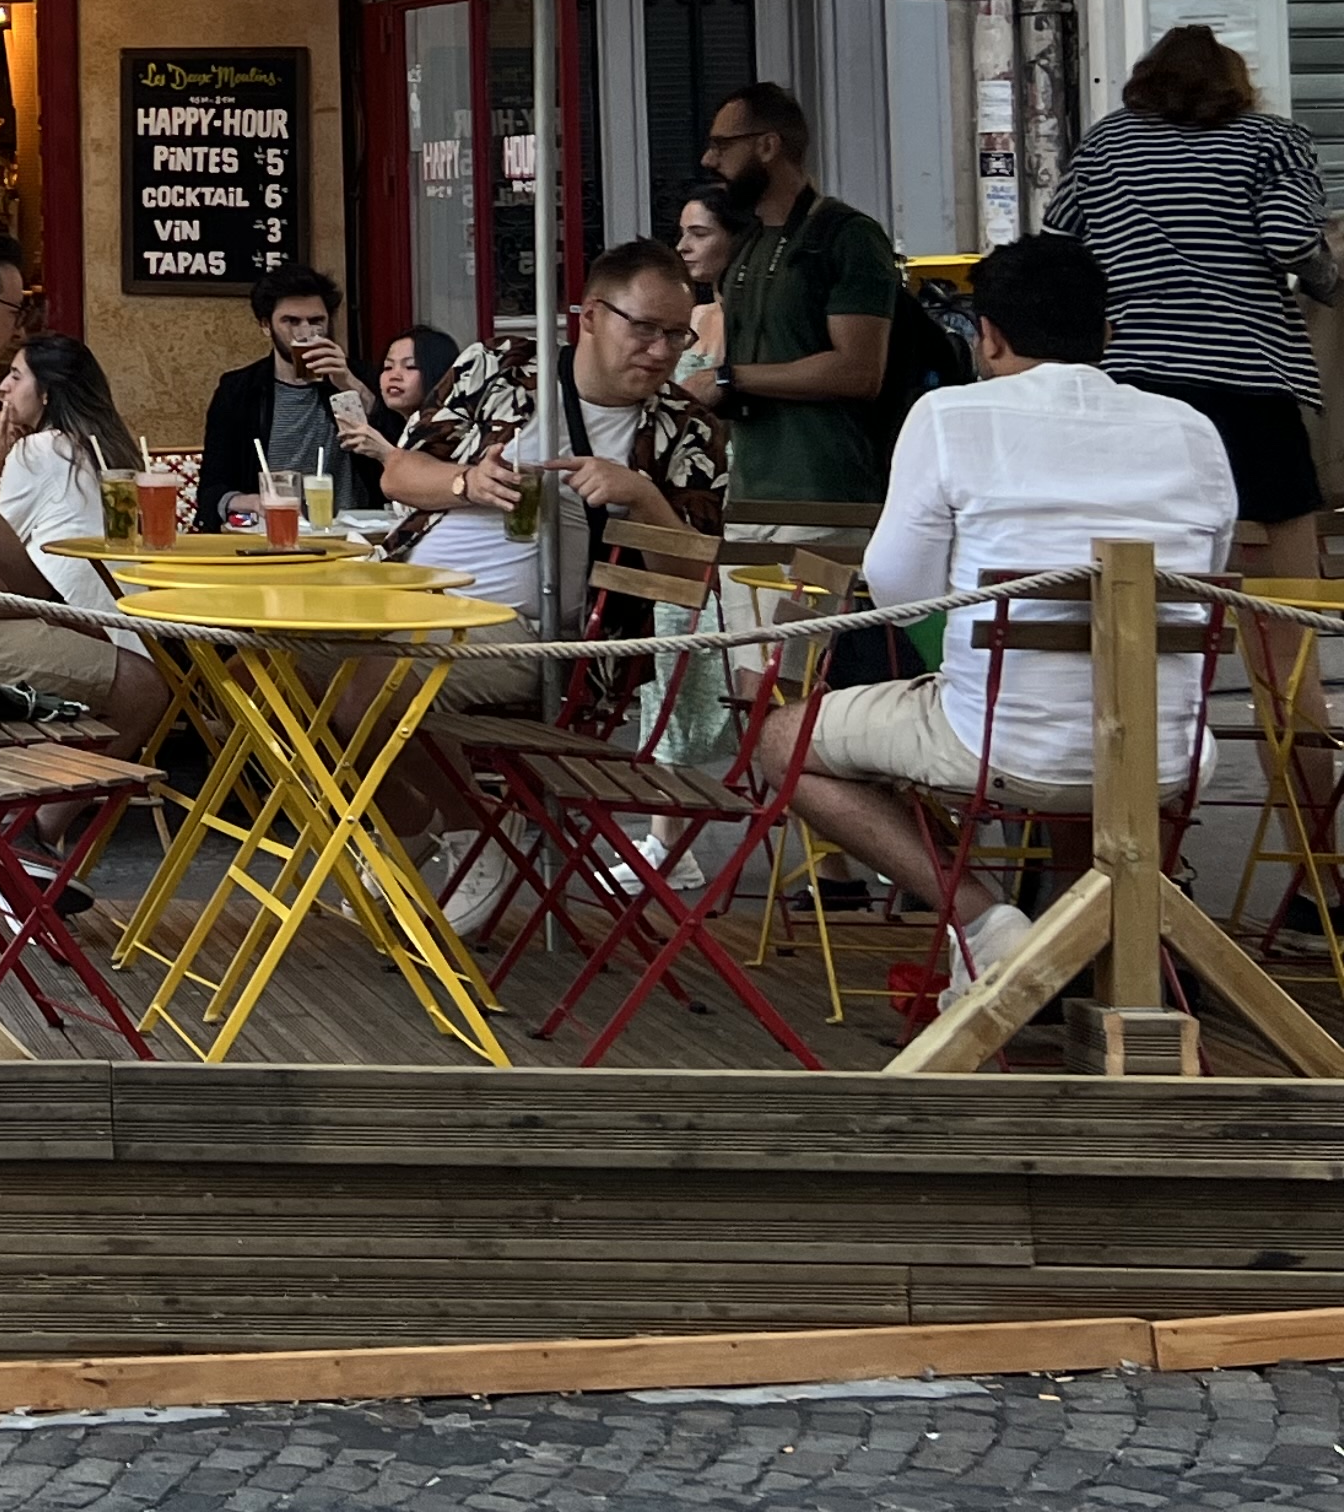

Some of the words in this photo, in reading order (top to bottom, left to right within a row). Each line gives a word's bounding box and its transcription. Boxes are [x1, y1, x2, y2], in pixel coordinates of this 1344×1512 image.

[141, 62, 166, 87] Les
[166, 62, 213, 90] Deux
[211, 64, 276, 89] Moulins
[137, 106, 289, 139] HAPPY-HOUR
[422, 139, 460, 181] HAPPY
[143, 251, 227, 276] TAPAS
